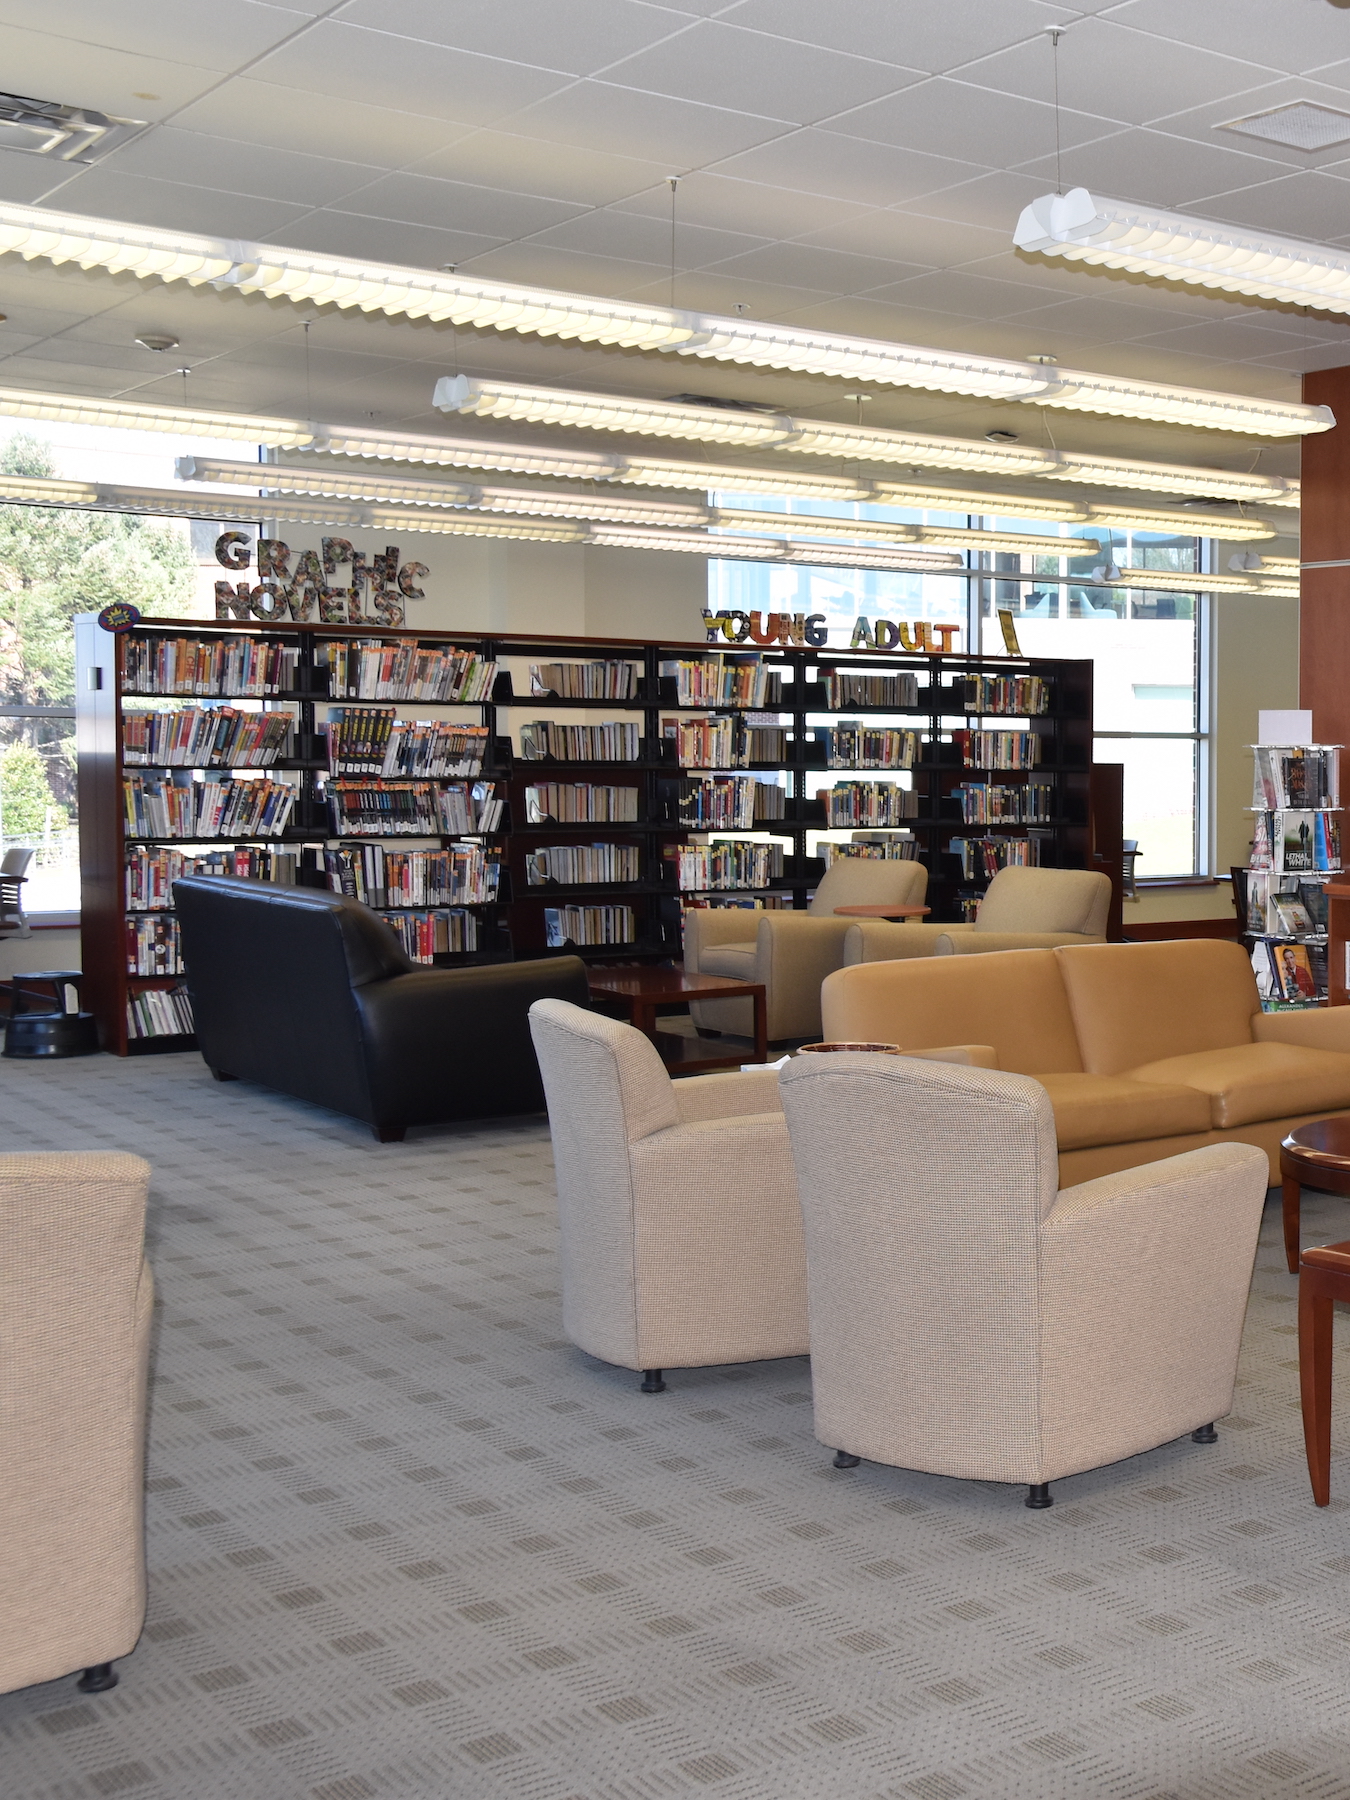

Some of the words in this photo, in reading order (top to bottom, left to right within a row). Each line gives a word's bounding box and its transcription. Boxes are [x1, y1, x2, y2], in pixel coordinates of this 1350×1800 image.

[215, 531, 431, 599] GRAPHIC
[215, 580, 404, 626] NOVELS
[700, 608, 828, 647] YOUNG
[850, 616, 959, 652] ADULT
[1286, 852, 1308, 861] LETHAL
[1288, 859, 1311, 867] WHITE
